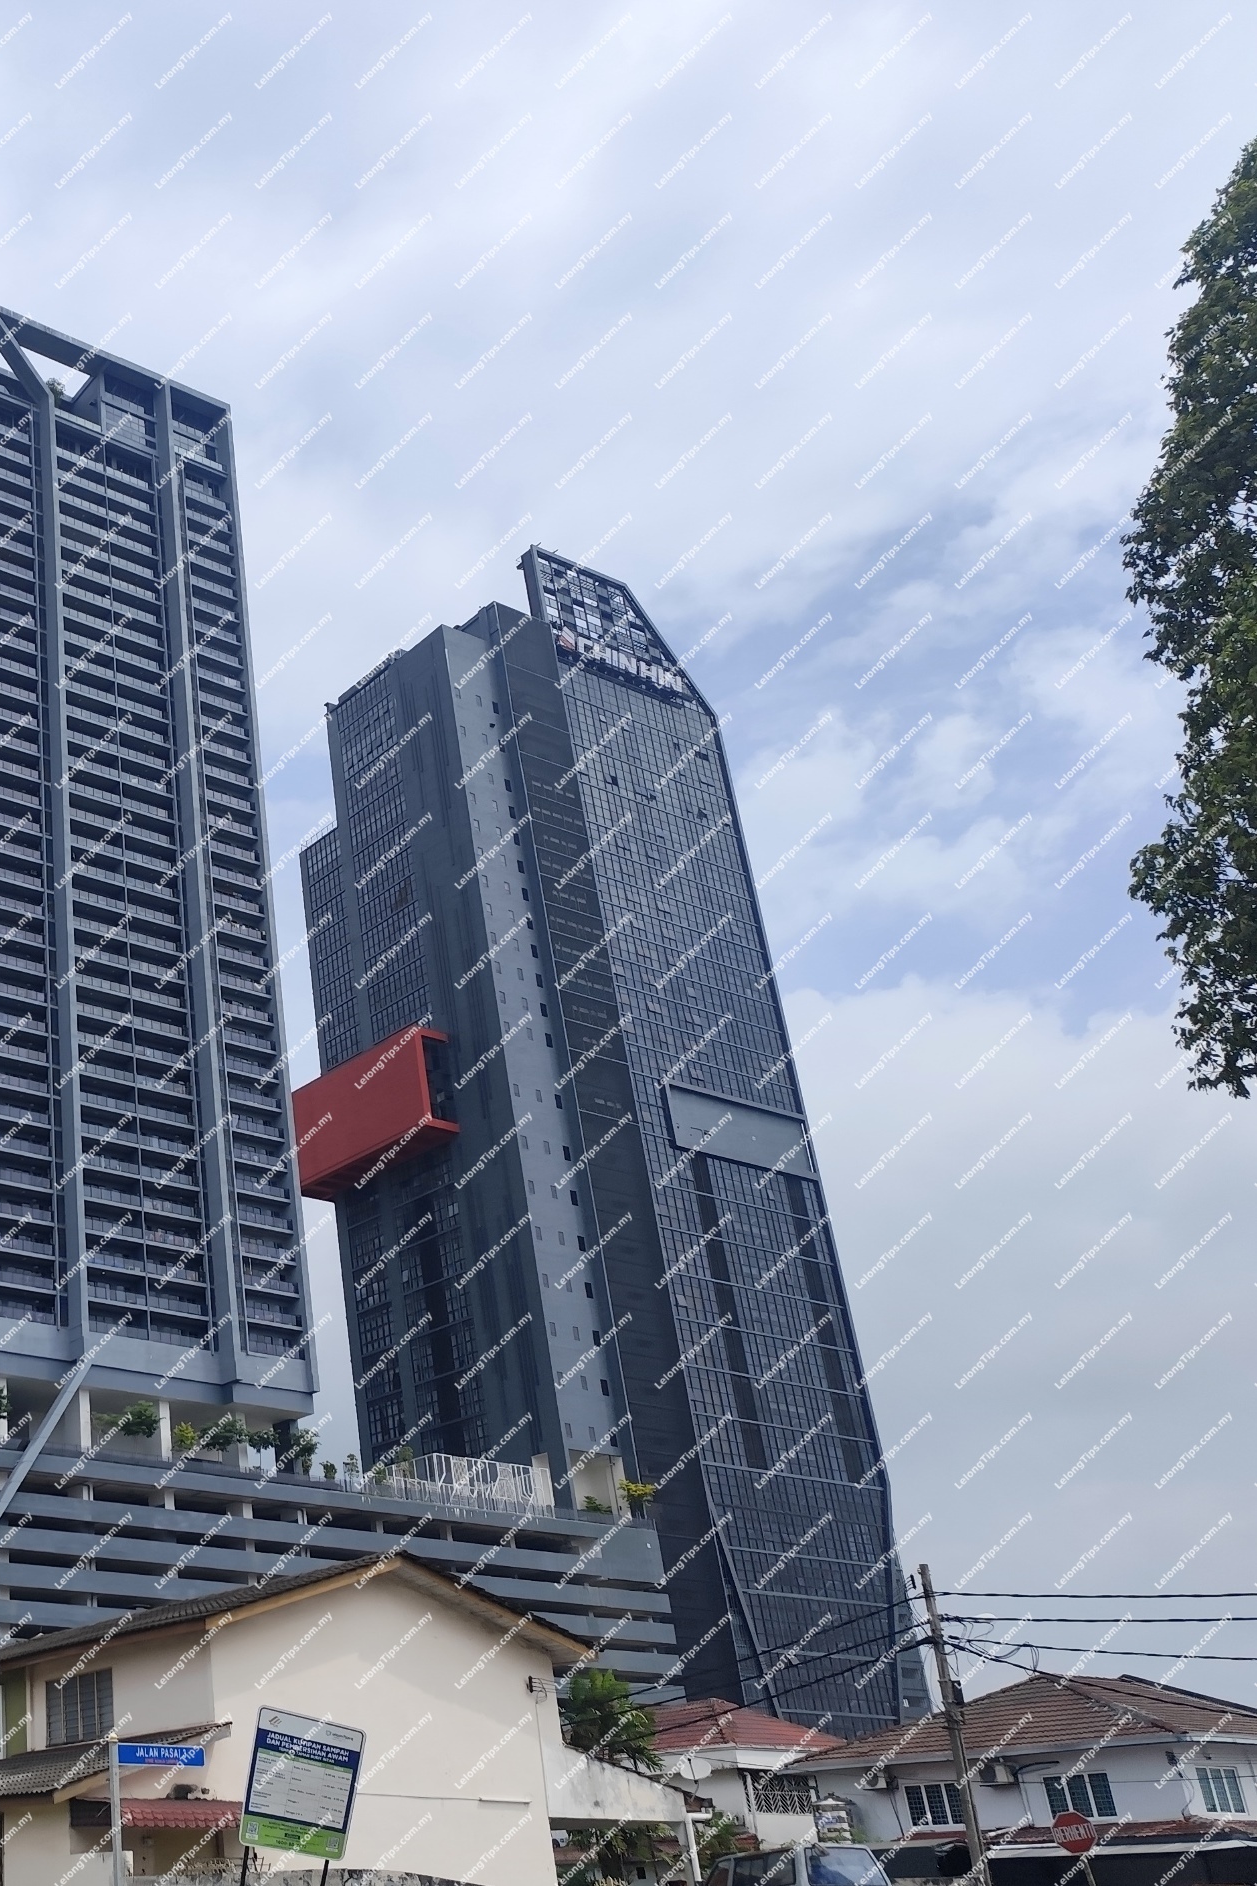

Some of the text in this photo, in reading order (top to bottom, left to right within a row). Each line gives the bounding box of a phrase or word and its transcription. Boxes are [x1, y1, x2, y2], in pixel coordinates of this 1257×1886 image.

[577, 636, 683, 693] CHIN HIN
[136, 1747, 159, 1758] JALAN
[266, 1738, 281, 1747] DAN
[327, 1752, 349, 1763] AWAM
[267, 1732, 292, 1743] JADUAL
[322, 1745, 350, 1756] SAMPAH
[1053, 1823, 1095, 1843] BERHENTI
